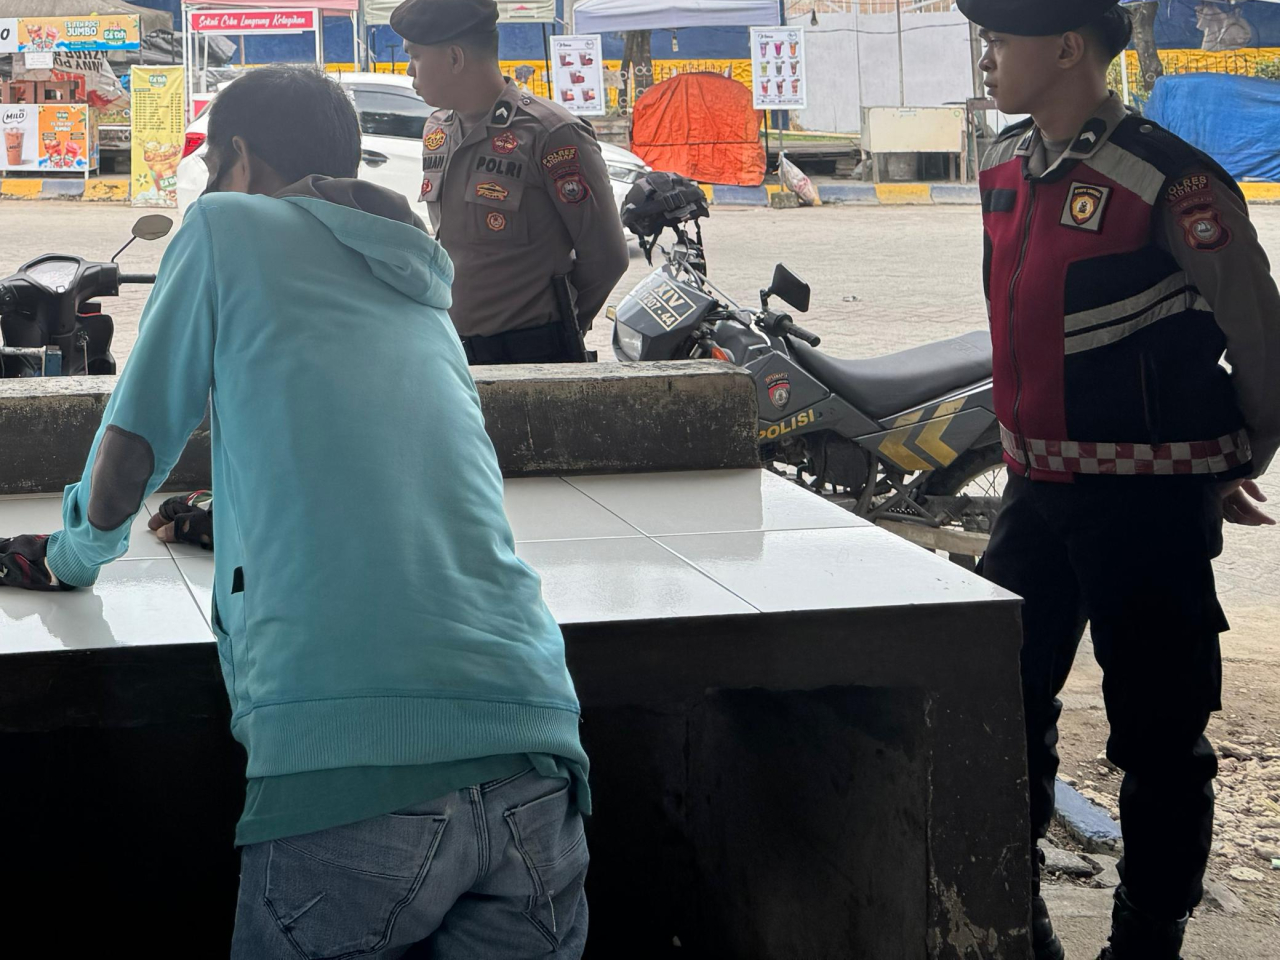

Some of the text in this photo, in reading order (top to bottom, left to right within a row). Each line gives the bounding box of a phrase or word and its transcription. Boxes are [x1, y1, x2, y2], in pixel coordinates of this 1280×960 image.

[66, 27, 97, 36] JUMBO
[5, 112, 25, 120] MILO
[476, 156, 523, 178] POLRI
[542, 148, 576, 165] POLRES
[1166, 175, 1207, 199] OLRES
[653, 282, 685, 307] XIV
[758, 408, 815, 439] POLISI
